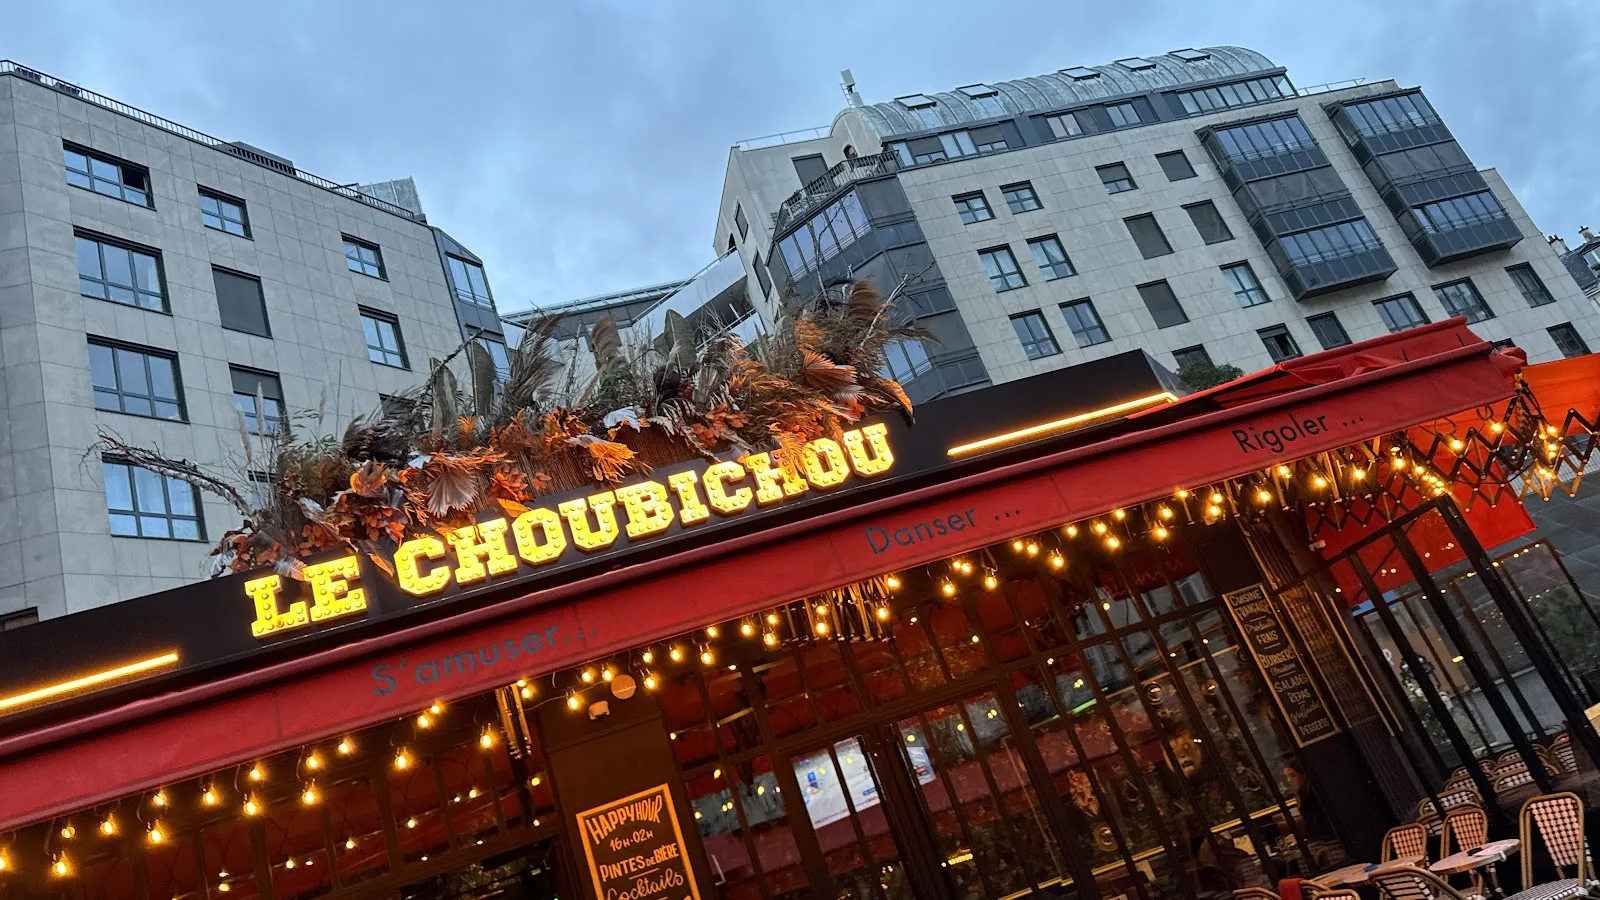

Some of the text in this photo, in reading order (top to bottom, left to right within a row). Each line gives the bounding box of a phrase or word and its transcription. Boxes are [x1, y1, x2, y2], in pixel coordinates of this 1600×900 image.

[1232, 413, 1329, 455] Rigoler
[244, 422, 895, 637] LE CHOUBICHOU
[864, 504, 978, 554] Danser
[1256, 630, 1279, 645] FRAIS
[1274, 672, 1309, 693] SALADES
[585, 794, 663, 845] HAPPY HOUR
[599, 843, 679, 882] PINTES DE BIÈRE
